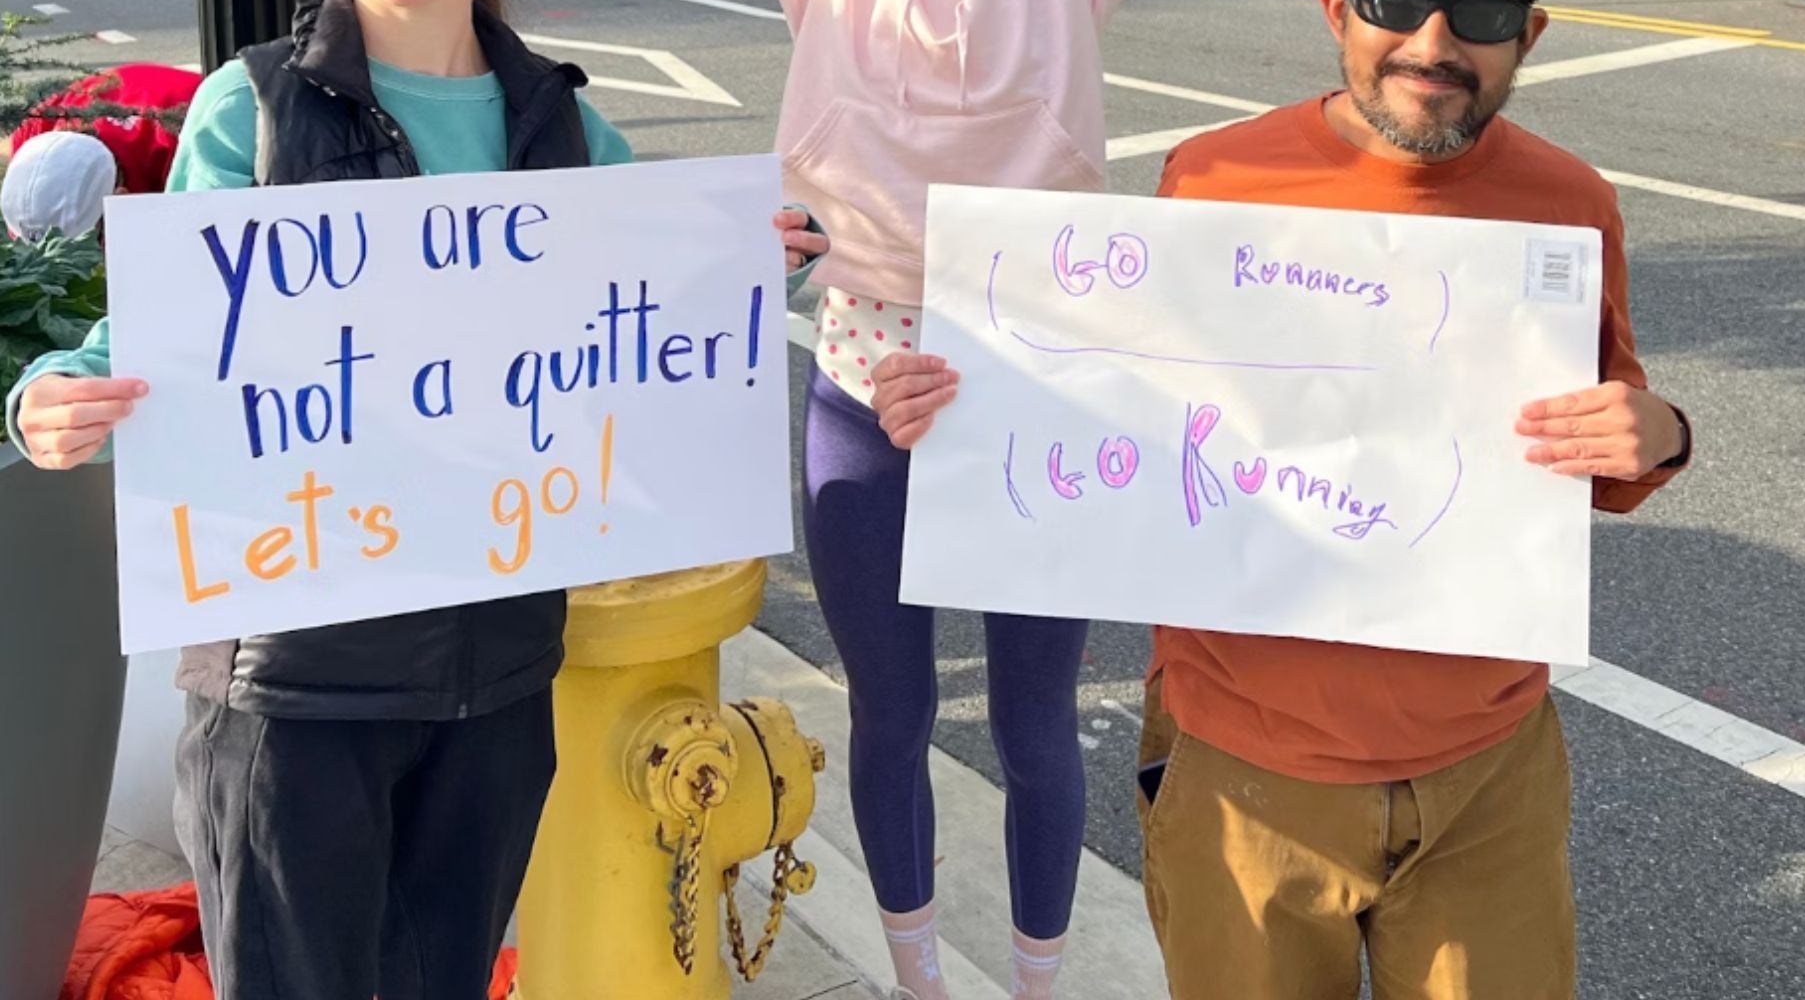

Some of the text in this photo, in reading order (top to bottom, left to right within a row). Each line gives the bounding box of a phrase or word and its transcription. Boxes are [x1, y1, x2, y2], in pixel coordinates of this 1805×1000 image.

[201, 203, 549, 381] you are
[241, 281, 763, 458] not a quitter!
[172, 413, 613, 604] Let's go!
